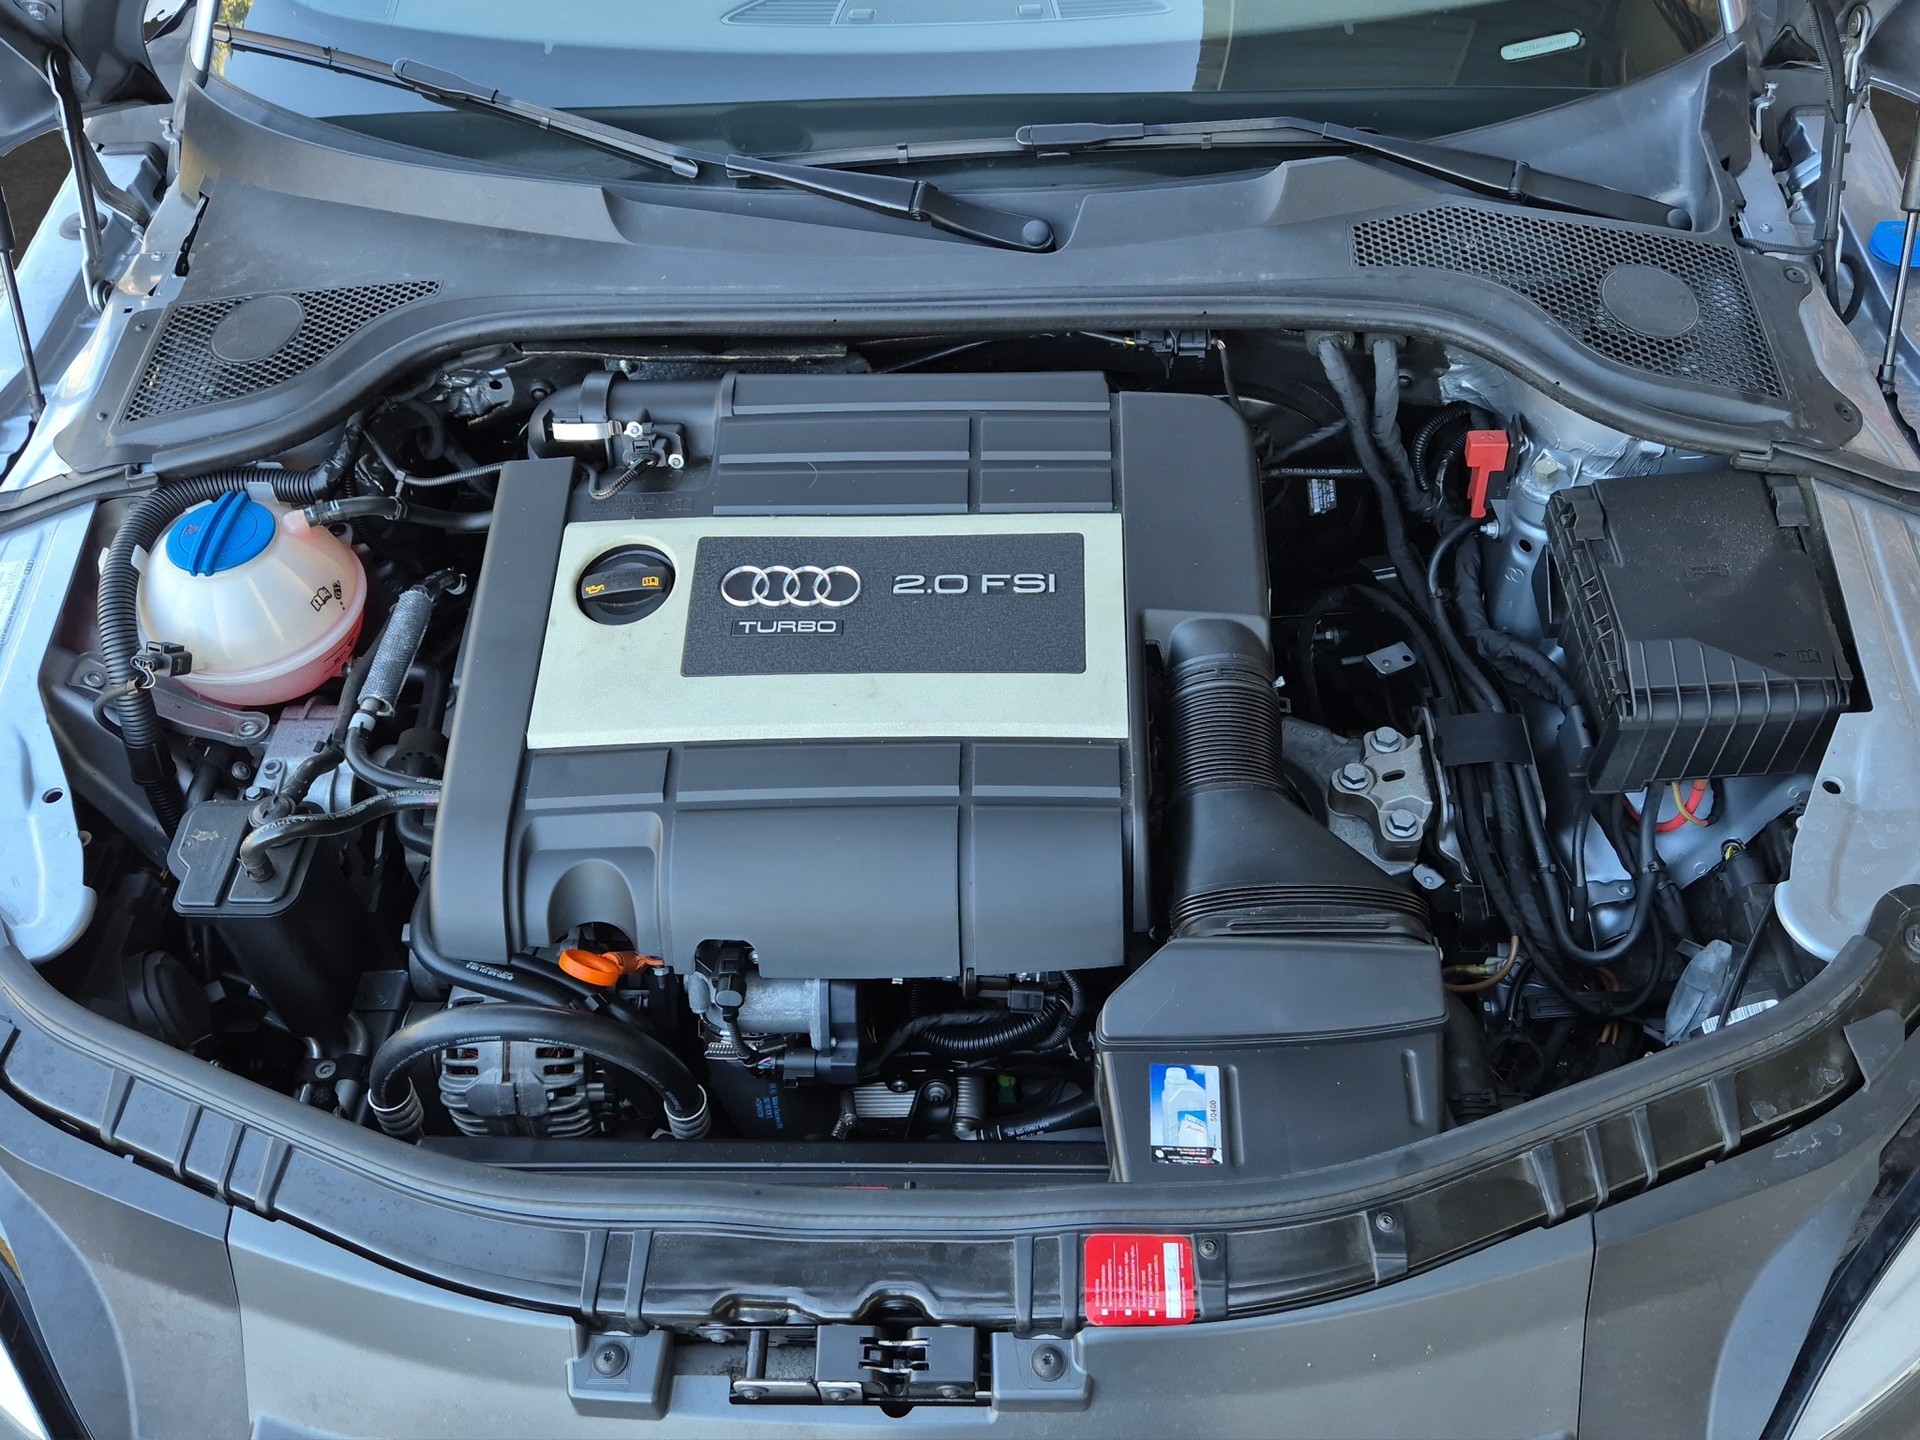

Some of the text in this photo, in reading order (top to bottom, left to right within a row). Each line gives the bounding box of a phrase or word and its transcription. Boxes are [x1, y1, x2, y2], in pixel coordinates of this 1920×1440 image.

[892, 573, 1056, 594] 2.0 FSI
[739, 620, 837, 634] TURBO
[1209, 1100, 1217, 1122] 50400
